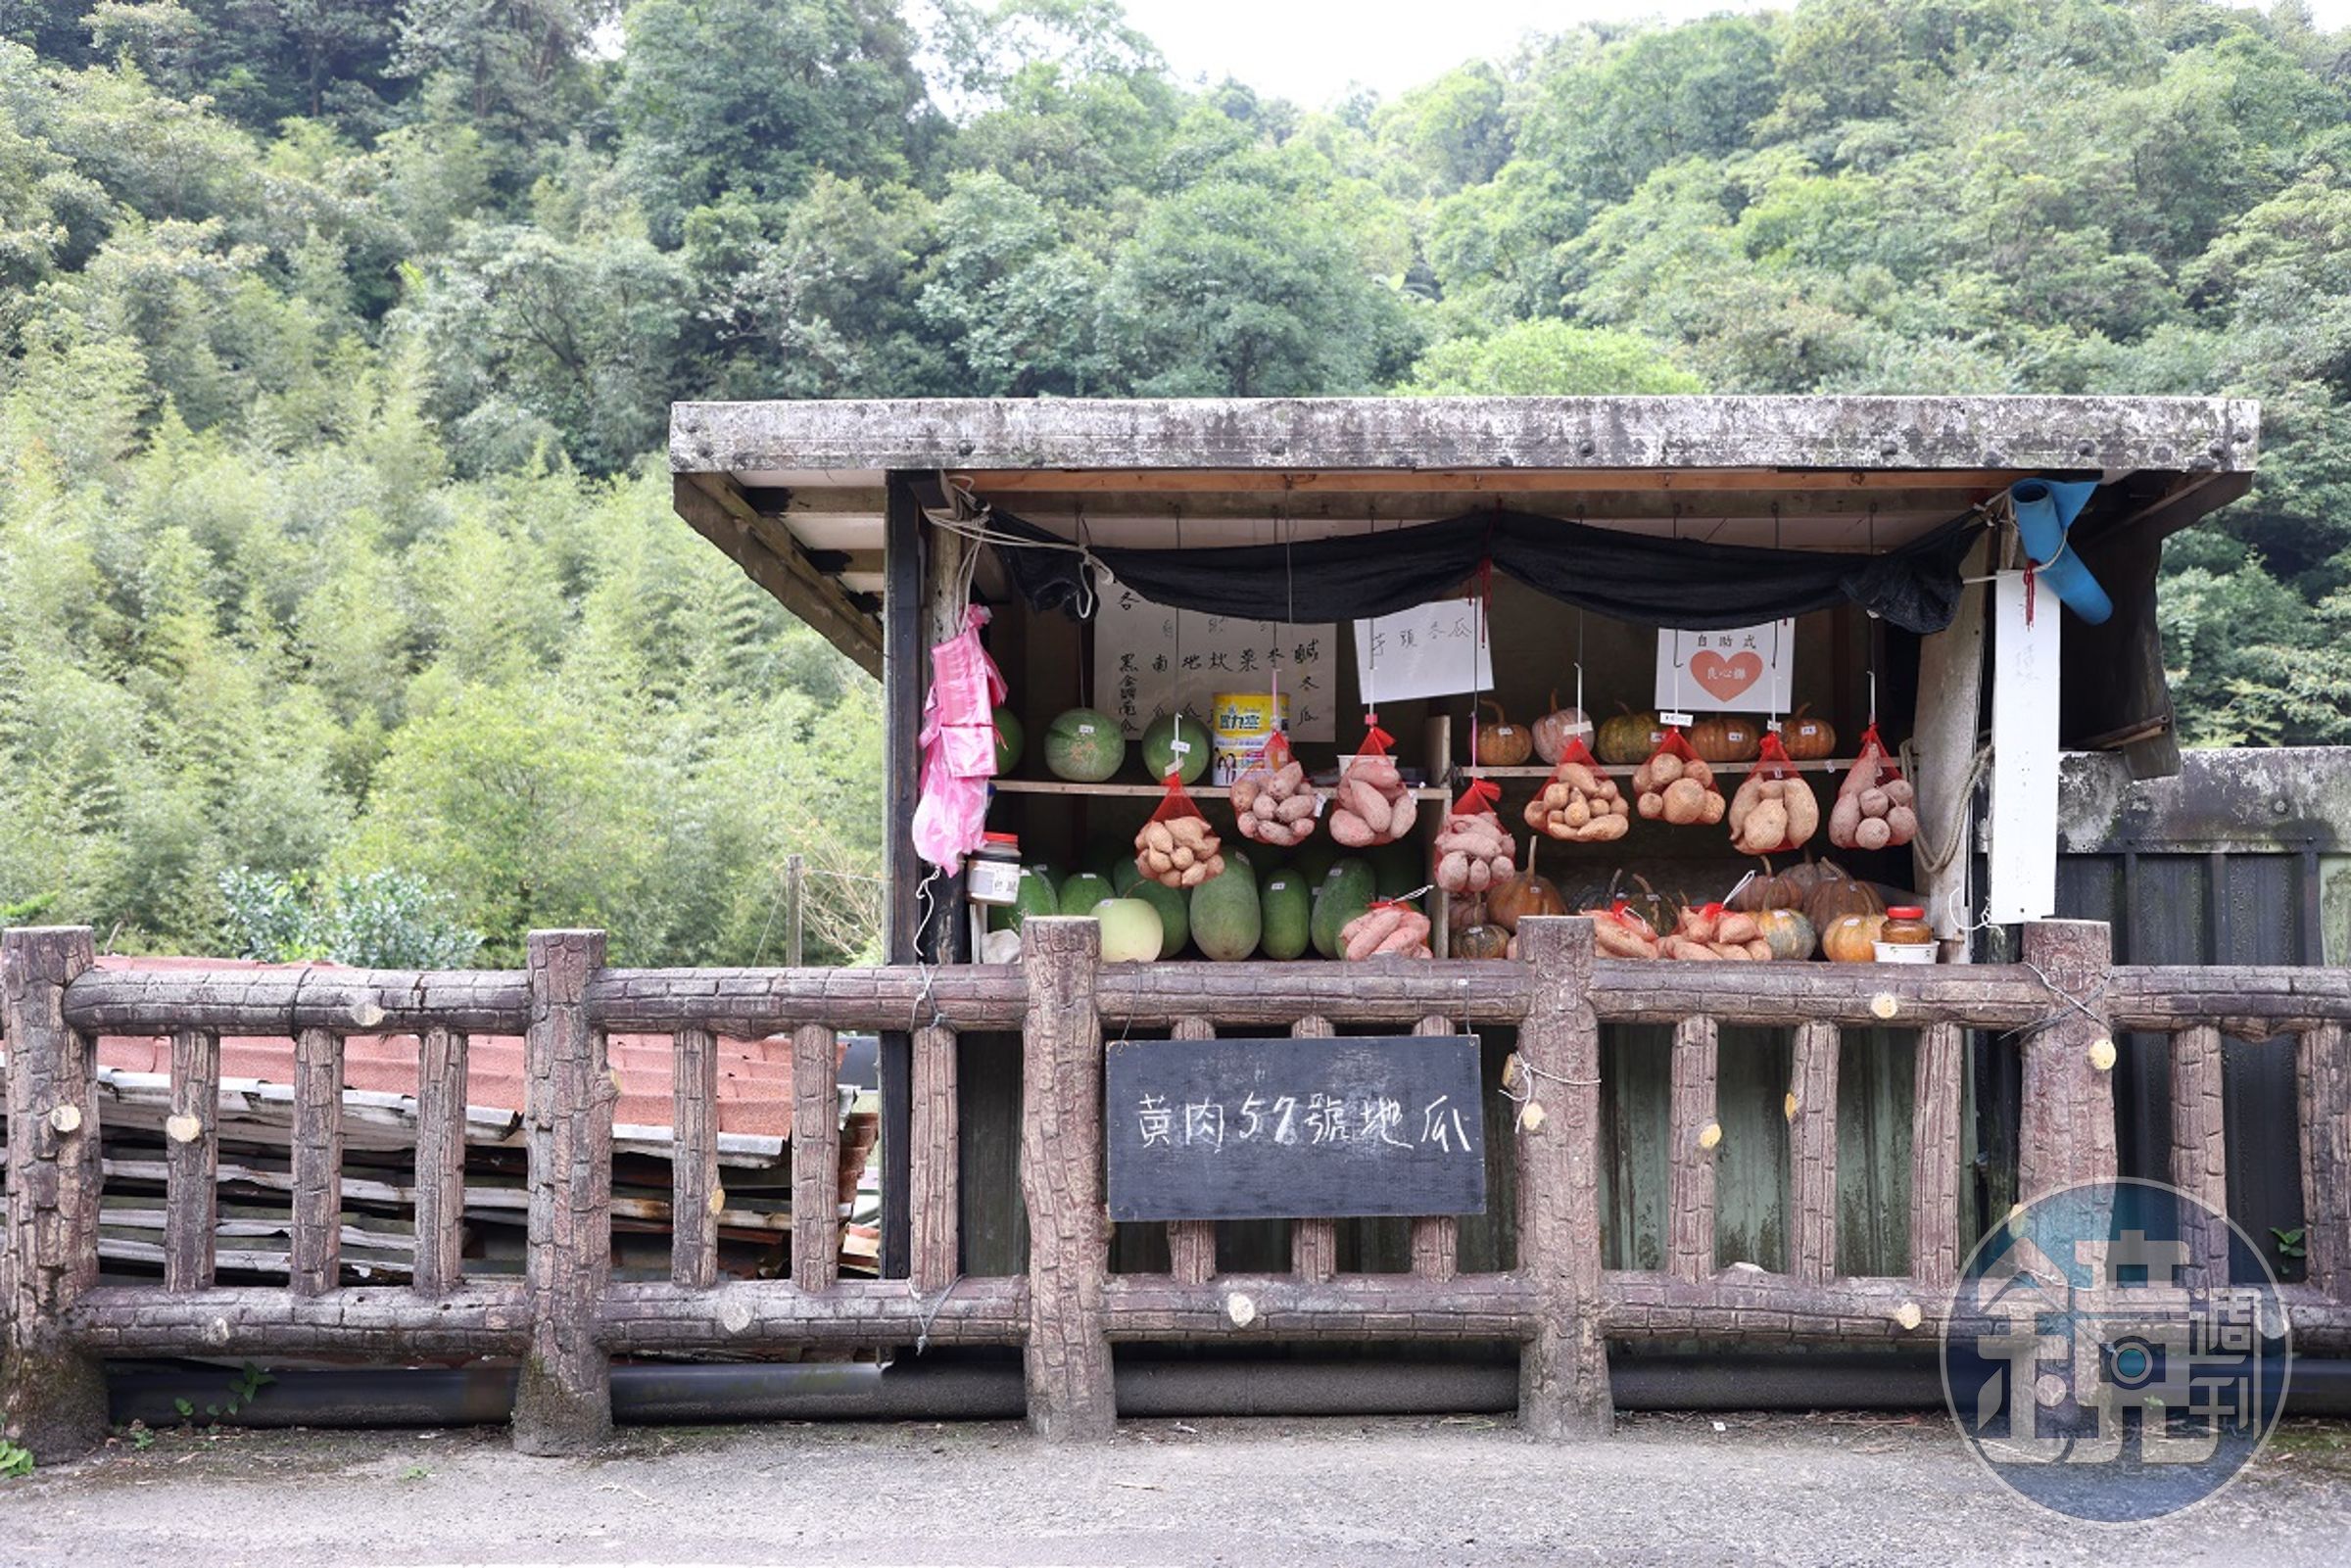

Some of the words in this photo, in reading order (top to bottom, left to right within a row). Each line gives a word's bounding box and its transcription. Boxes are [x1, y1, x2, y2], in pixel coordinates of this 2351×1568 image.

[1697, 634, 1757, 650] 自助式
[1137, 1091, 1472, 1154] 黃肉57號地瓜
